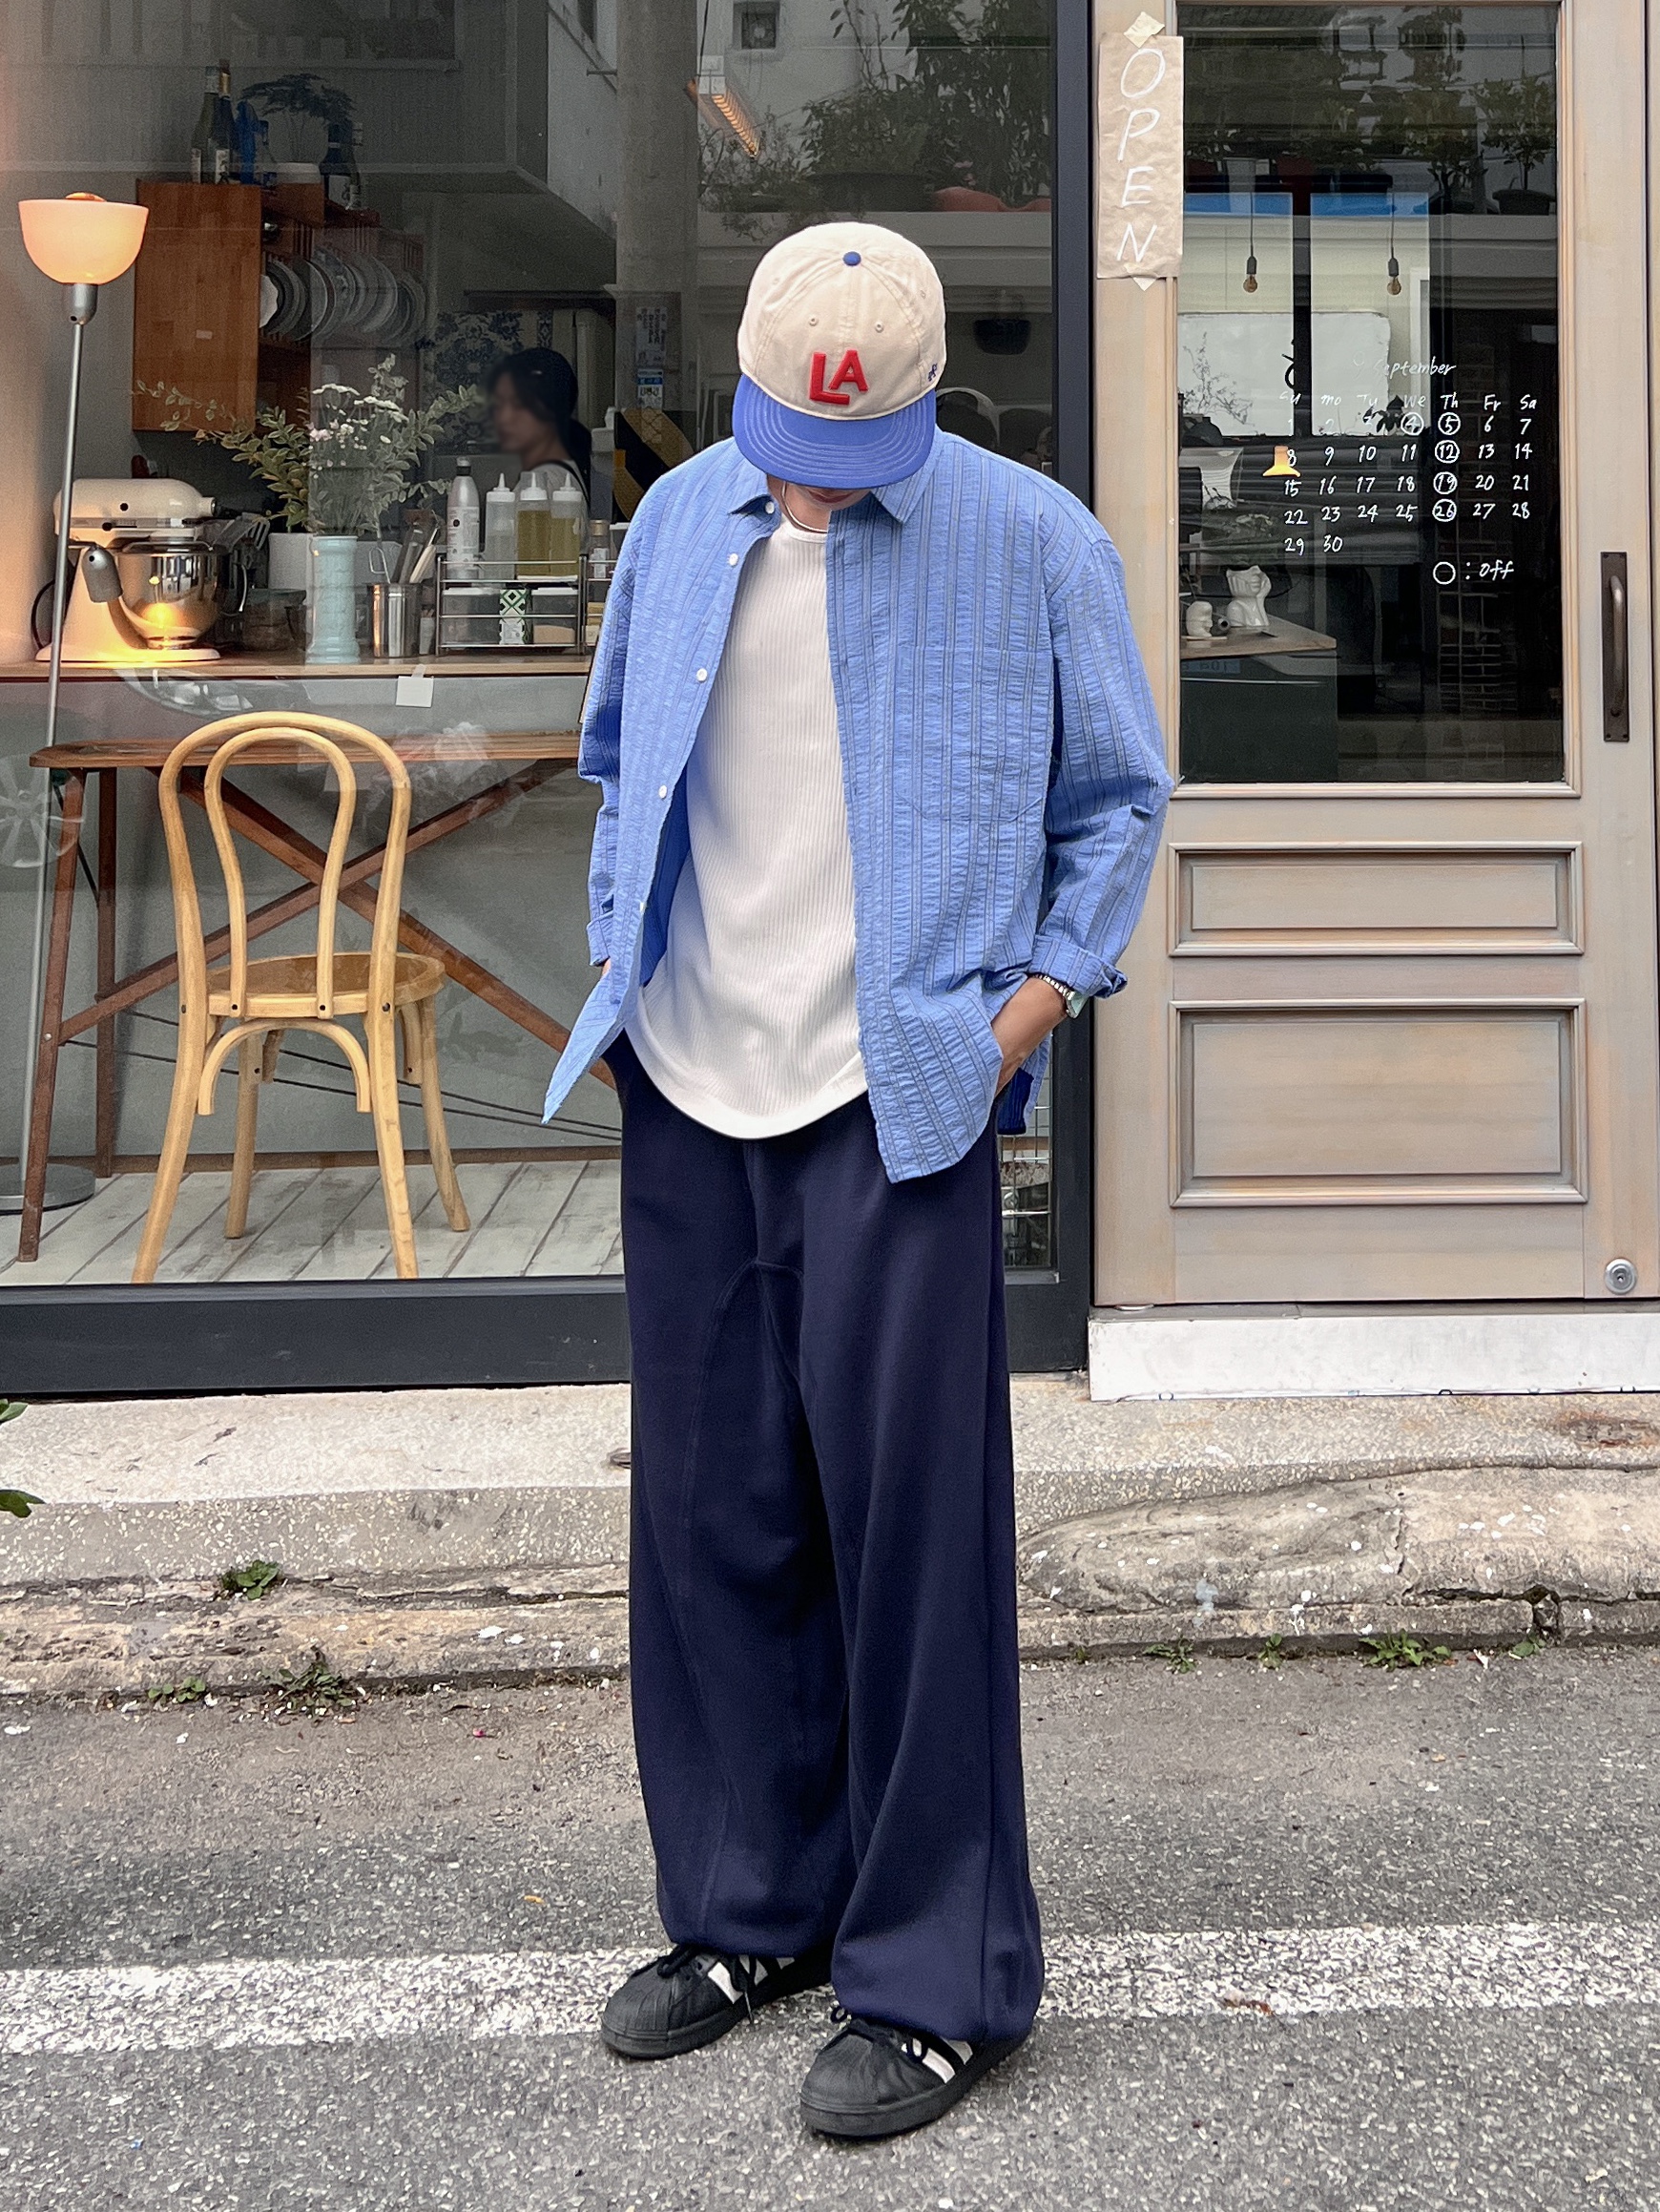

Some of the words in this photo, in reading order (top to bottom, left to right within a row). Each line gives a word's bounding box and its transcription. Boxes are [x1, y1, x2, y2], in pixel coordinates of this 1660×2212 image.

[1116, 48, 1167, 262] OPEN
[809, 349, 869, 406] LA
[1372, 356, 1457, 380] September
[1403, 394, 1426, 408] We
[1440, 391, 1459, 410] Th
[1484, 394, 1502, 411] Fr
[1520, 394, 1537, 410] Sa
[1484, 414, 1495, 432] 6
[1519, 418, 1532, 435] 7
[1287, 449, 1297, 467] 8
[1324, 446, 1335, 467] 9
[1358, 445, 1377, 463] 10
[1401, 444, 1417, 462] 11
[1478, 443, 1495, 459] 13
[1515, 443, 1533, 460] 14
[1284, 479, 1302, 497] 15
[1318, 475, 1338, 495] 16
[1356, 476, 1376, 493] 17
[1397, 475, 1415, 492] 18
[1475, 474, 1495, 491] 20
[1512, 473, 1529, 491] 21
[1283, 509, 1308, 525] 22
[1320, 506, 1340, 522] 23
[1357, 504, 1379, 523] 24
[1395, 504, 1418, 522] 25
[1472, 503, 1496, 520] 27
[1511, 501, 1530, 519] 28
[1284, 538, 1305, 556] 29
[1323, 535, 1343, 553] 30
